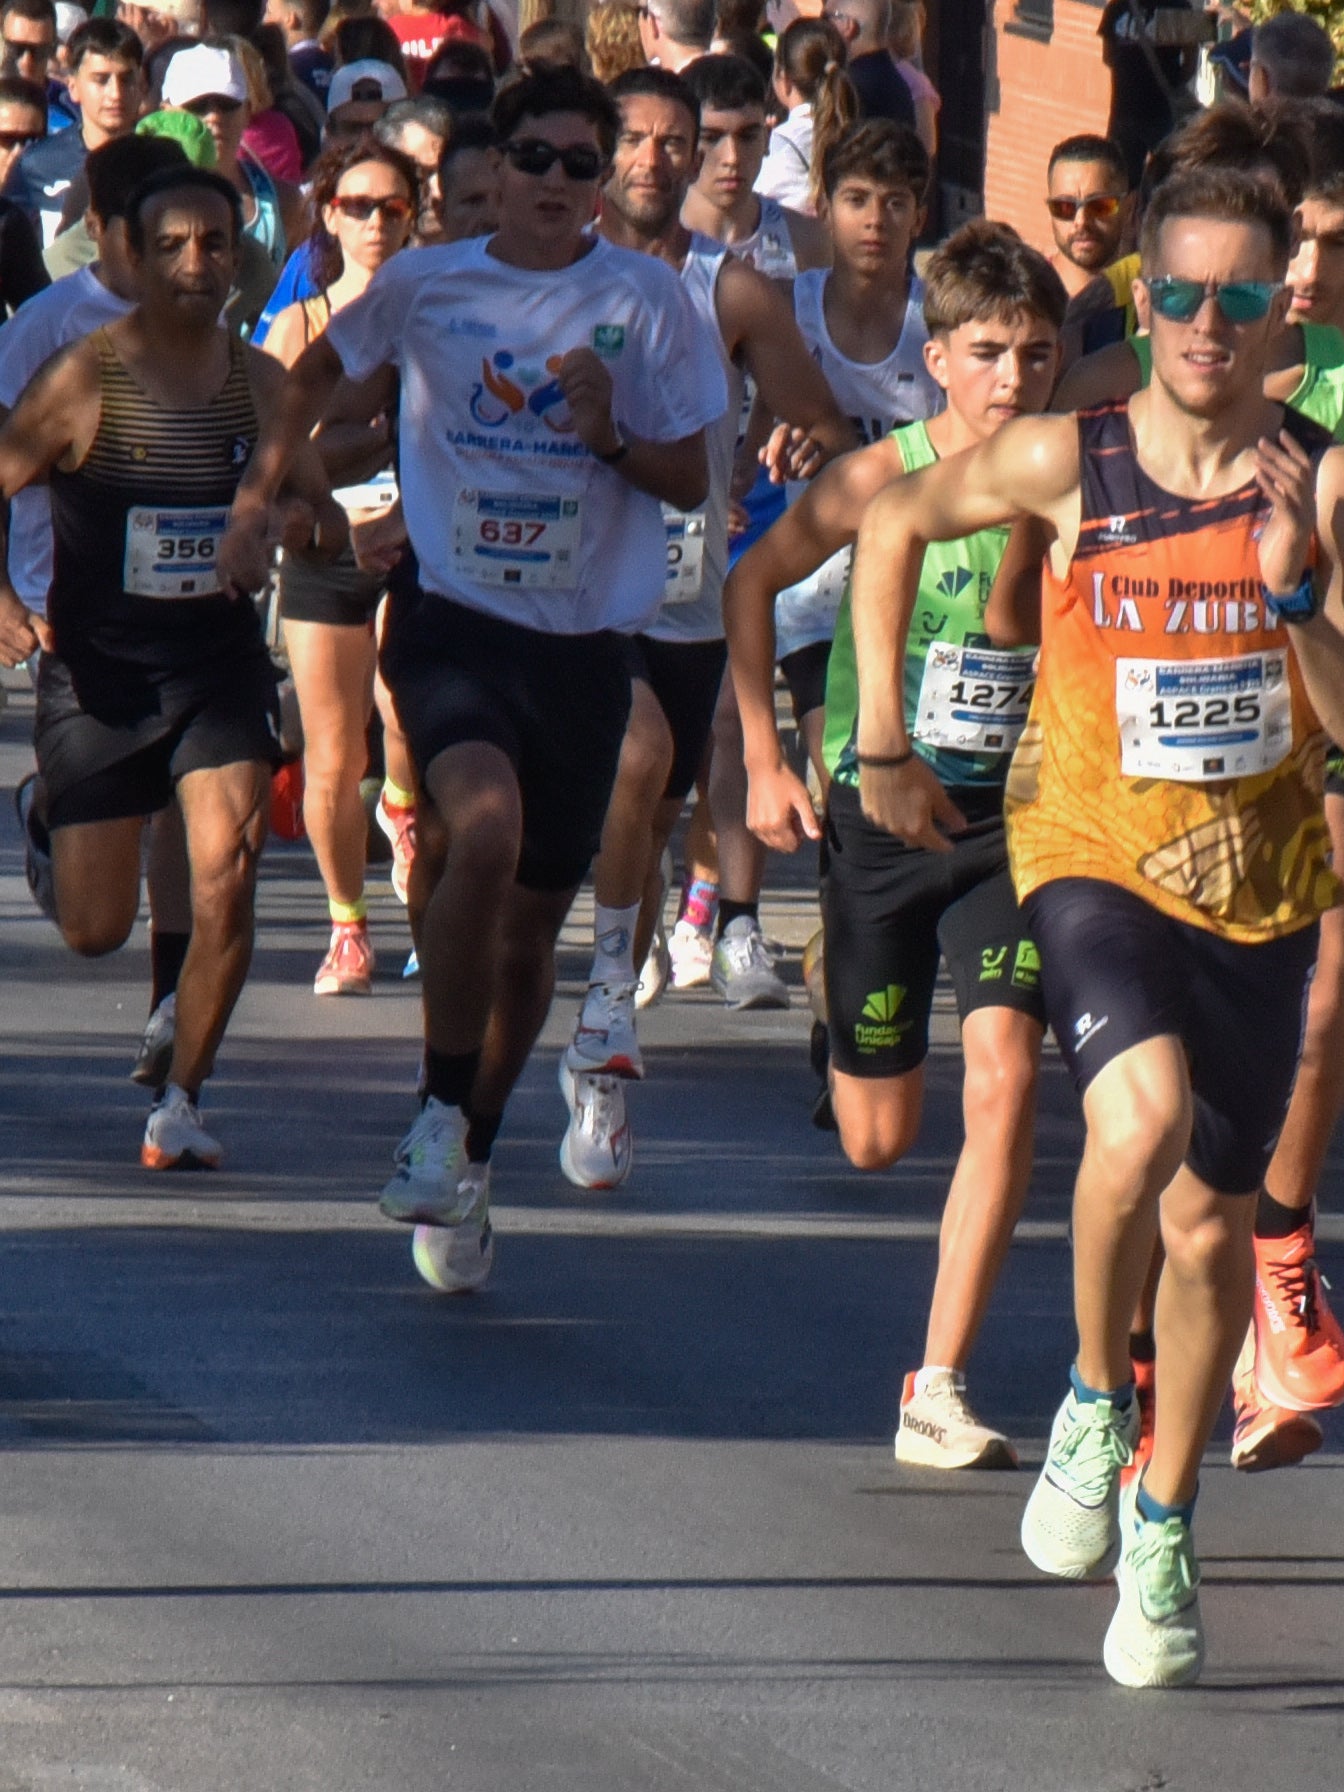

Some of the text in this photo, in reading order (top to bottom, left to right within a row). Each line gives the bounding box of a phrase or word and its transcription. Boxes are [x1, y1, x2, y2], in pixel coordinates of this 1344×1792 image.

[480, 519, 547, 546] 637
[157, 537, 215, 559] 356
[1111, 575, 1159, 596] Club
[1092, 572, 1143, 632] LA
[1150, 694, 1261, 728] 1225
